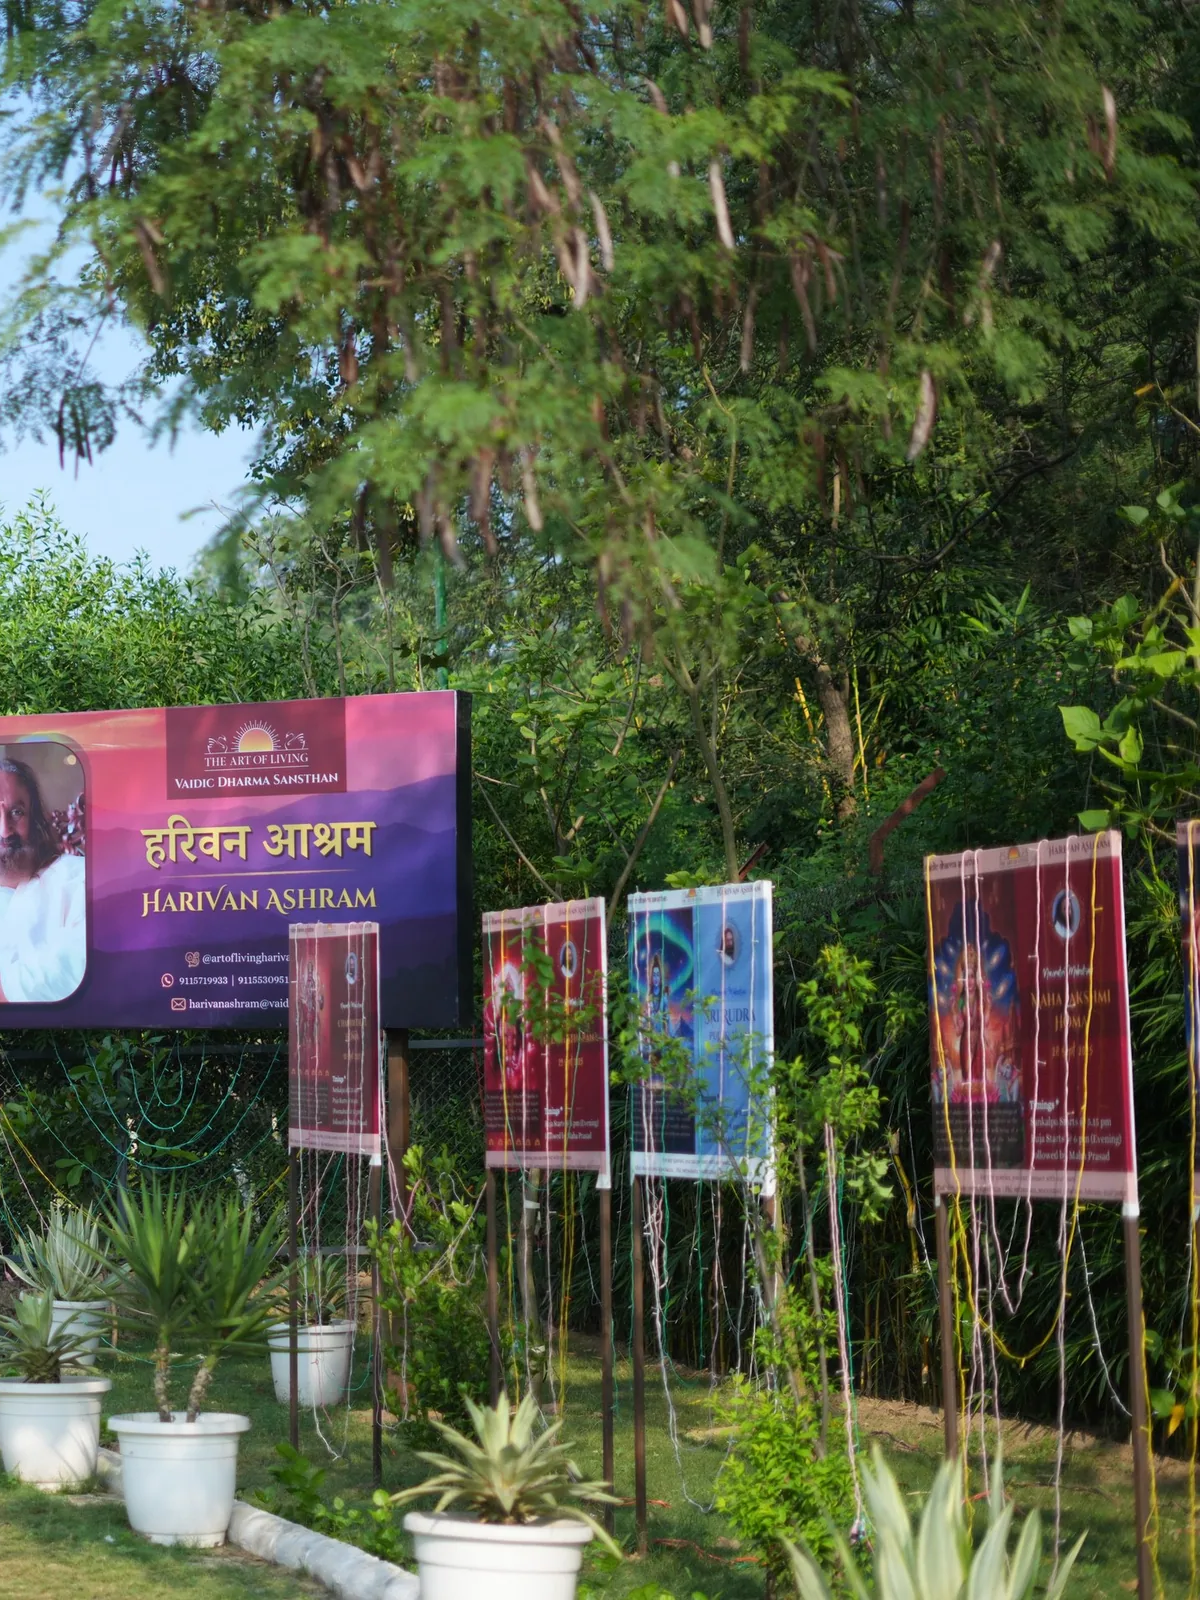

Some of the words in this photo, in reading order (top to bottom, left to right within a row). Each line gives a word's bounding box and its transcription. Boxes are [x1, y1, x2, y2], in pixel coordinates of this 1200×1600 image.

[204, 757, 226, 768] THE
[230, 755, 252, 766] ART
[253, 754, 267, 765] OF
[270, 752, 309, 764] LIVING
[175, 777, 215, 790] VAIDIC
[218, 775, 270, 788] DHARMA
[273, 772, 338, 786] SANSTHAN
[140, 814, 252, 869] हरिवन
[263, 820, 378, 860] आश्रम
[141, 884, 259, 918] HARIVAN
[265, 886, 378, 915] ASHRAM
[179, 976, 228, 986] 9115719933
[237, 975, 289, 985] 9115530951
[1030, 988, 1112, 1009] MAHAAKSMI
